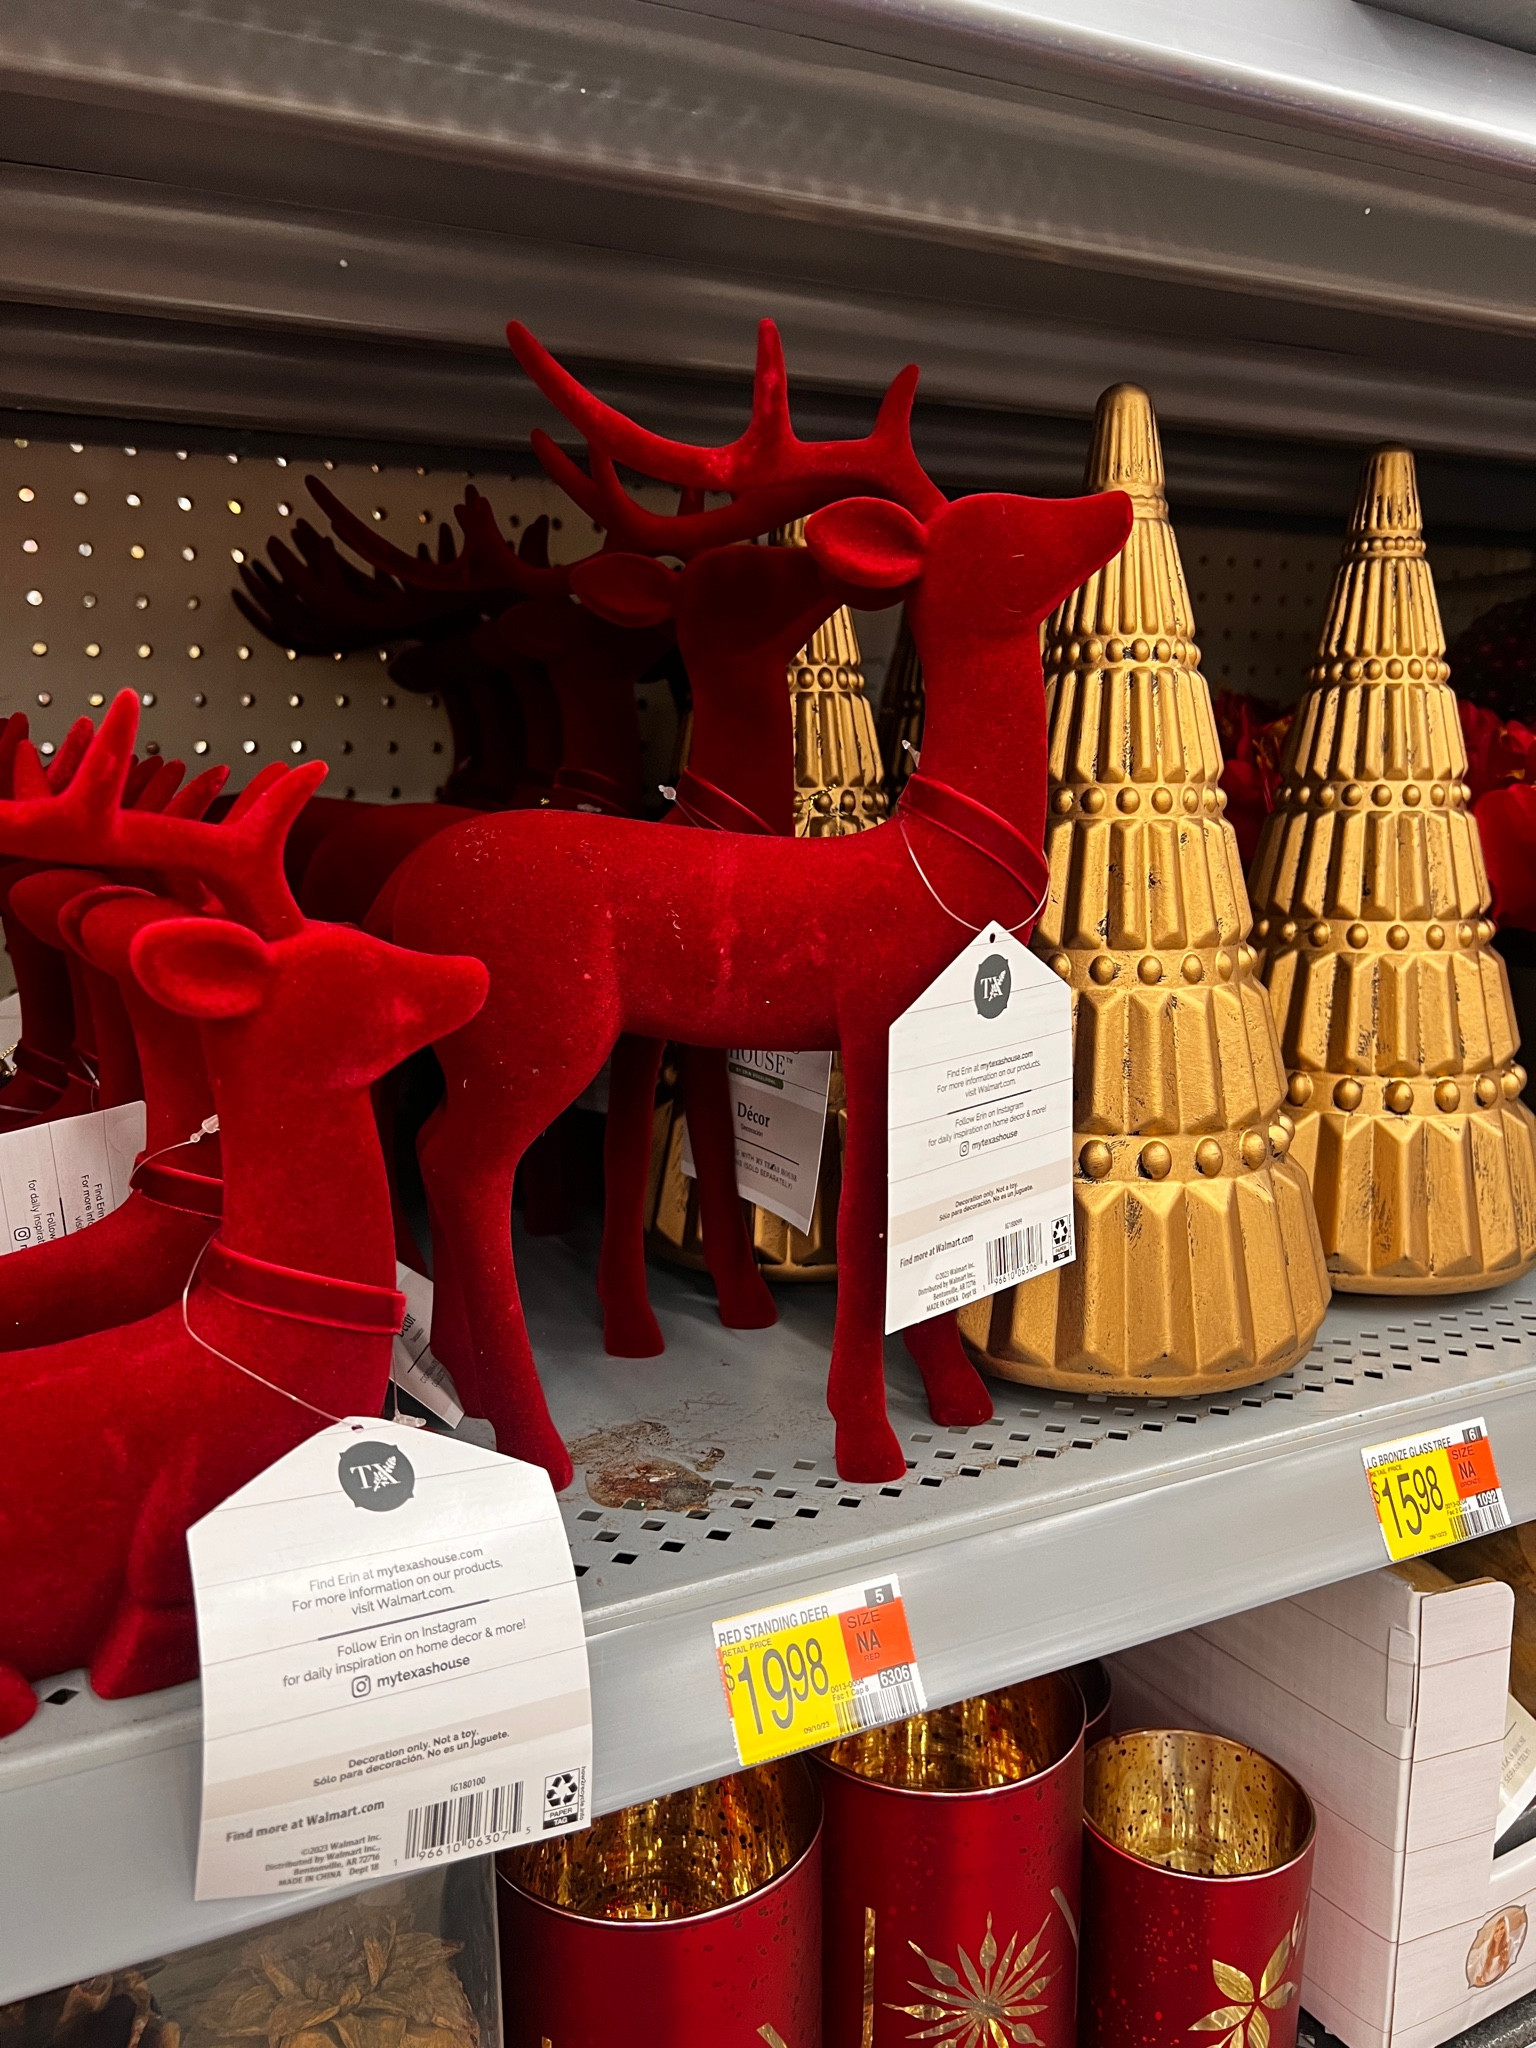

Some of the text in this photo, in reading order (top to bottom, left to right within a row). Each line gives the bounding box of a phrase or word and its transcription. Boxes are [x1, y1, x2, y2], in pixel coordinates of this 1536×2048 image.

[946, 1051, 1033, 1079] Find Erin at mytexashouse.com
[936, 1067, 1016, 1093] For more information on our
[965, 1088, 977, 1097] visit
[737, 1101, 771, 1128] Décor
[928, 1138, 937, 1148] for
[938, 1133, 952, 1144] daily
[953, 1124, 983, 1140] inspiration
[984, 1122, 992, 1131] on
[992, 1117, 1009, 1128] home
[1010, 1112, 1025, 1123] decor
[1031, 1104, 1047, 1116] more!
[955, 1102, 1024, 1128] Follow Erin on Instagram
[972, 1130, 1018, 1150] mytexashouse
[81, 1174, 90, 1188] For
[94, 1183, 104, 1202] Find
[28, 1179, 39, 1213] for daily
[83, 1189, 93, 1211] more
[951, 1208, 963, 1219] para
[1007, 1190, 1014, 1198] un
[955, 1194, 983, 1208] Decoration
[996, 1185, 1005, 1195] Not
[900, 1234, 974, 1268] Find more at Walmart.com
[994, 1264, 1037, 1286] 96610 06306
[1469, 1429, 1476, 1441] 6
[1366, 1436, 1452, 1469] LG BRONZE GLASS TREE
[1451, 1446, 1475, 1460] SIZE
[1458, 1460, 1477, 1480] NA
[1477, 1489, 1498, 1506] 1092
[309, 1548, 483, 1591] Find Erin at mytexashouse.com
[292, 1599, 312, 1612] For
[315, 1593, 346, 1608] more
[349, 1577, 414, 1599] information
[416, 1574, 431, 1585] on
[433, 1570, 451, 1582] our
[351, 1585, 455, 1616] visit Walmart.com.
[875, 1588, 885, 1604] 5
[718, 1605, 830, 1647] RED STANDING DEER
[847, 1609, 881, 1629] SIZE
[337, 1616, 477, 1657] Follow Erin on Instagram
[722, 1638, 772, 1658] RETAIL PRICE
[856, 1628, 881, 1654] NA
[282, 1618, 526, 1687] for daily inspiration on home decor & more!
[864, 1652, 880, 1662] RED
[377, 1655, 470, 1688] mytexashouse
[879, 1664, 910, 1686] 6306
[348, 1747, 405, 1768] Decoration
[407, 1741, 431, 1757] only.
[433, 1736, 451, 1747] Not
[461, 1729, 479, 1742] toy.
[313, 1773, 337, 1787] Sólo
[339, 1769, 363, 1783] para
[366, 1751, 425, 1774] decoración.
[427, 1748, 442, 1759] No
[443, 1745, 455, 1754] es
[457, 1741, 470, 1751] un
[450, 1776, 486, 1792] IG180100
[226, 1800, 385, 1843] Find more at Walmart.com
[549, 1807, 573, 1818] PAPER
[553, 1816, 568, 1826] TAG
[330, 1836, 366, 1850] Walmart
[368, 1833, 382, 1842] Inc.
[418, 1827, 531, 1861] 96610 06307 5
[265, 1856, 312, 1871] Distributed
[314, 1854, 325, 1864] by
[327, 1847, 362, 1861] Walmart
[294, 1853, 380, 1875] Bentonville, AR 72716
[278, 1862, 380, 1886] MADE IN CHINA Dept 18
